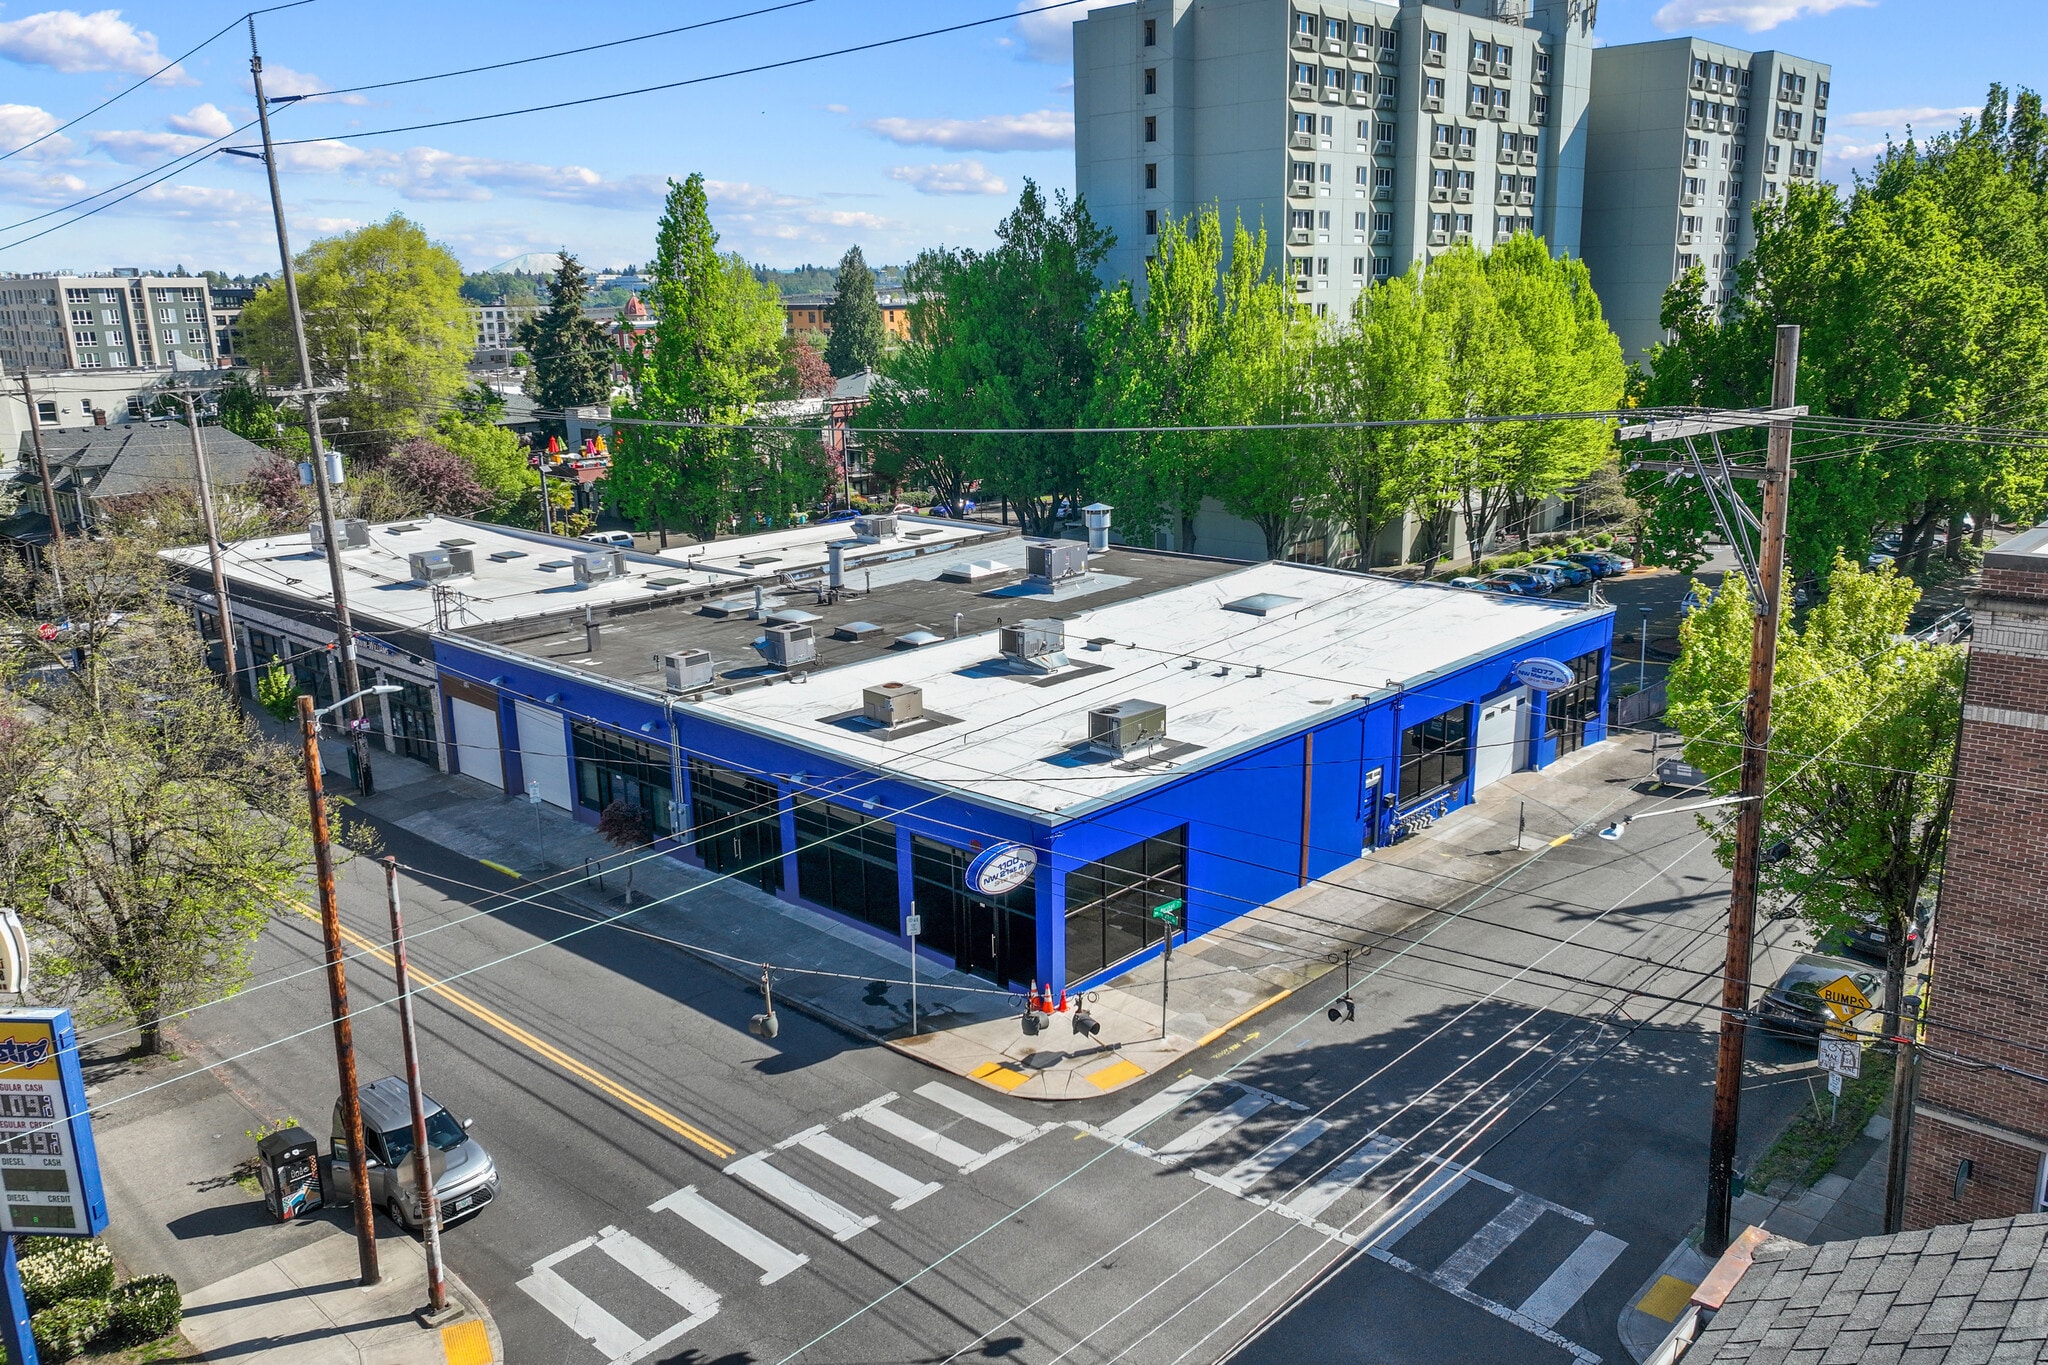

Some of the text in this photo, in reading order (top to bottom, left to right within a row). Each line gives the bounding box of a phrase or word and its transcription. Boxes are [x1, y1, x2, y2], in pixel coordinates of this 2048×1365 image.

[1518, 669, 1530, 677] NW
[1531, 667, 1554, 676] 2077
[998, 857, 1019, 871] 1100
[983, 873, 999, 886] NW
[1000, 866, 1018, 878] 21st
[1825, 990, 1865, 1007] BUMPS
[24, 1084, 44, 1093] CASH
[2, 1157, 62, 1167] DIESEL CASH
[6, 1194, 71, 1203] DIESEL CREDIT
